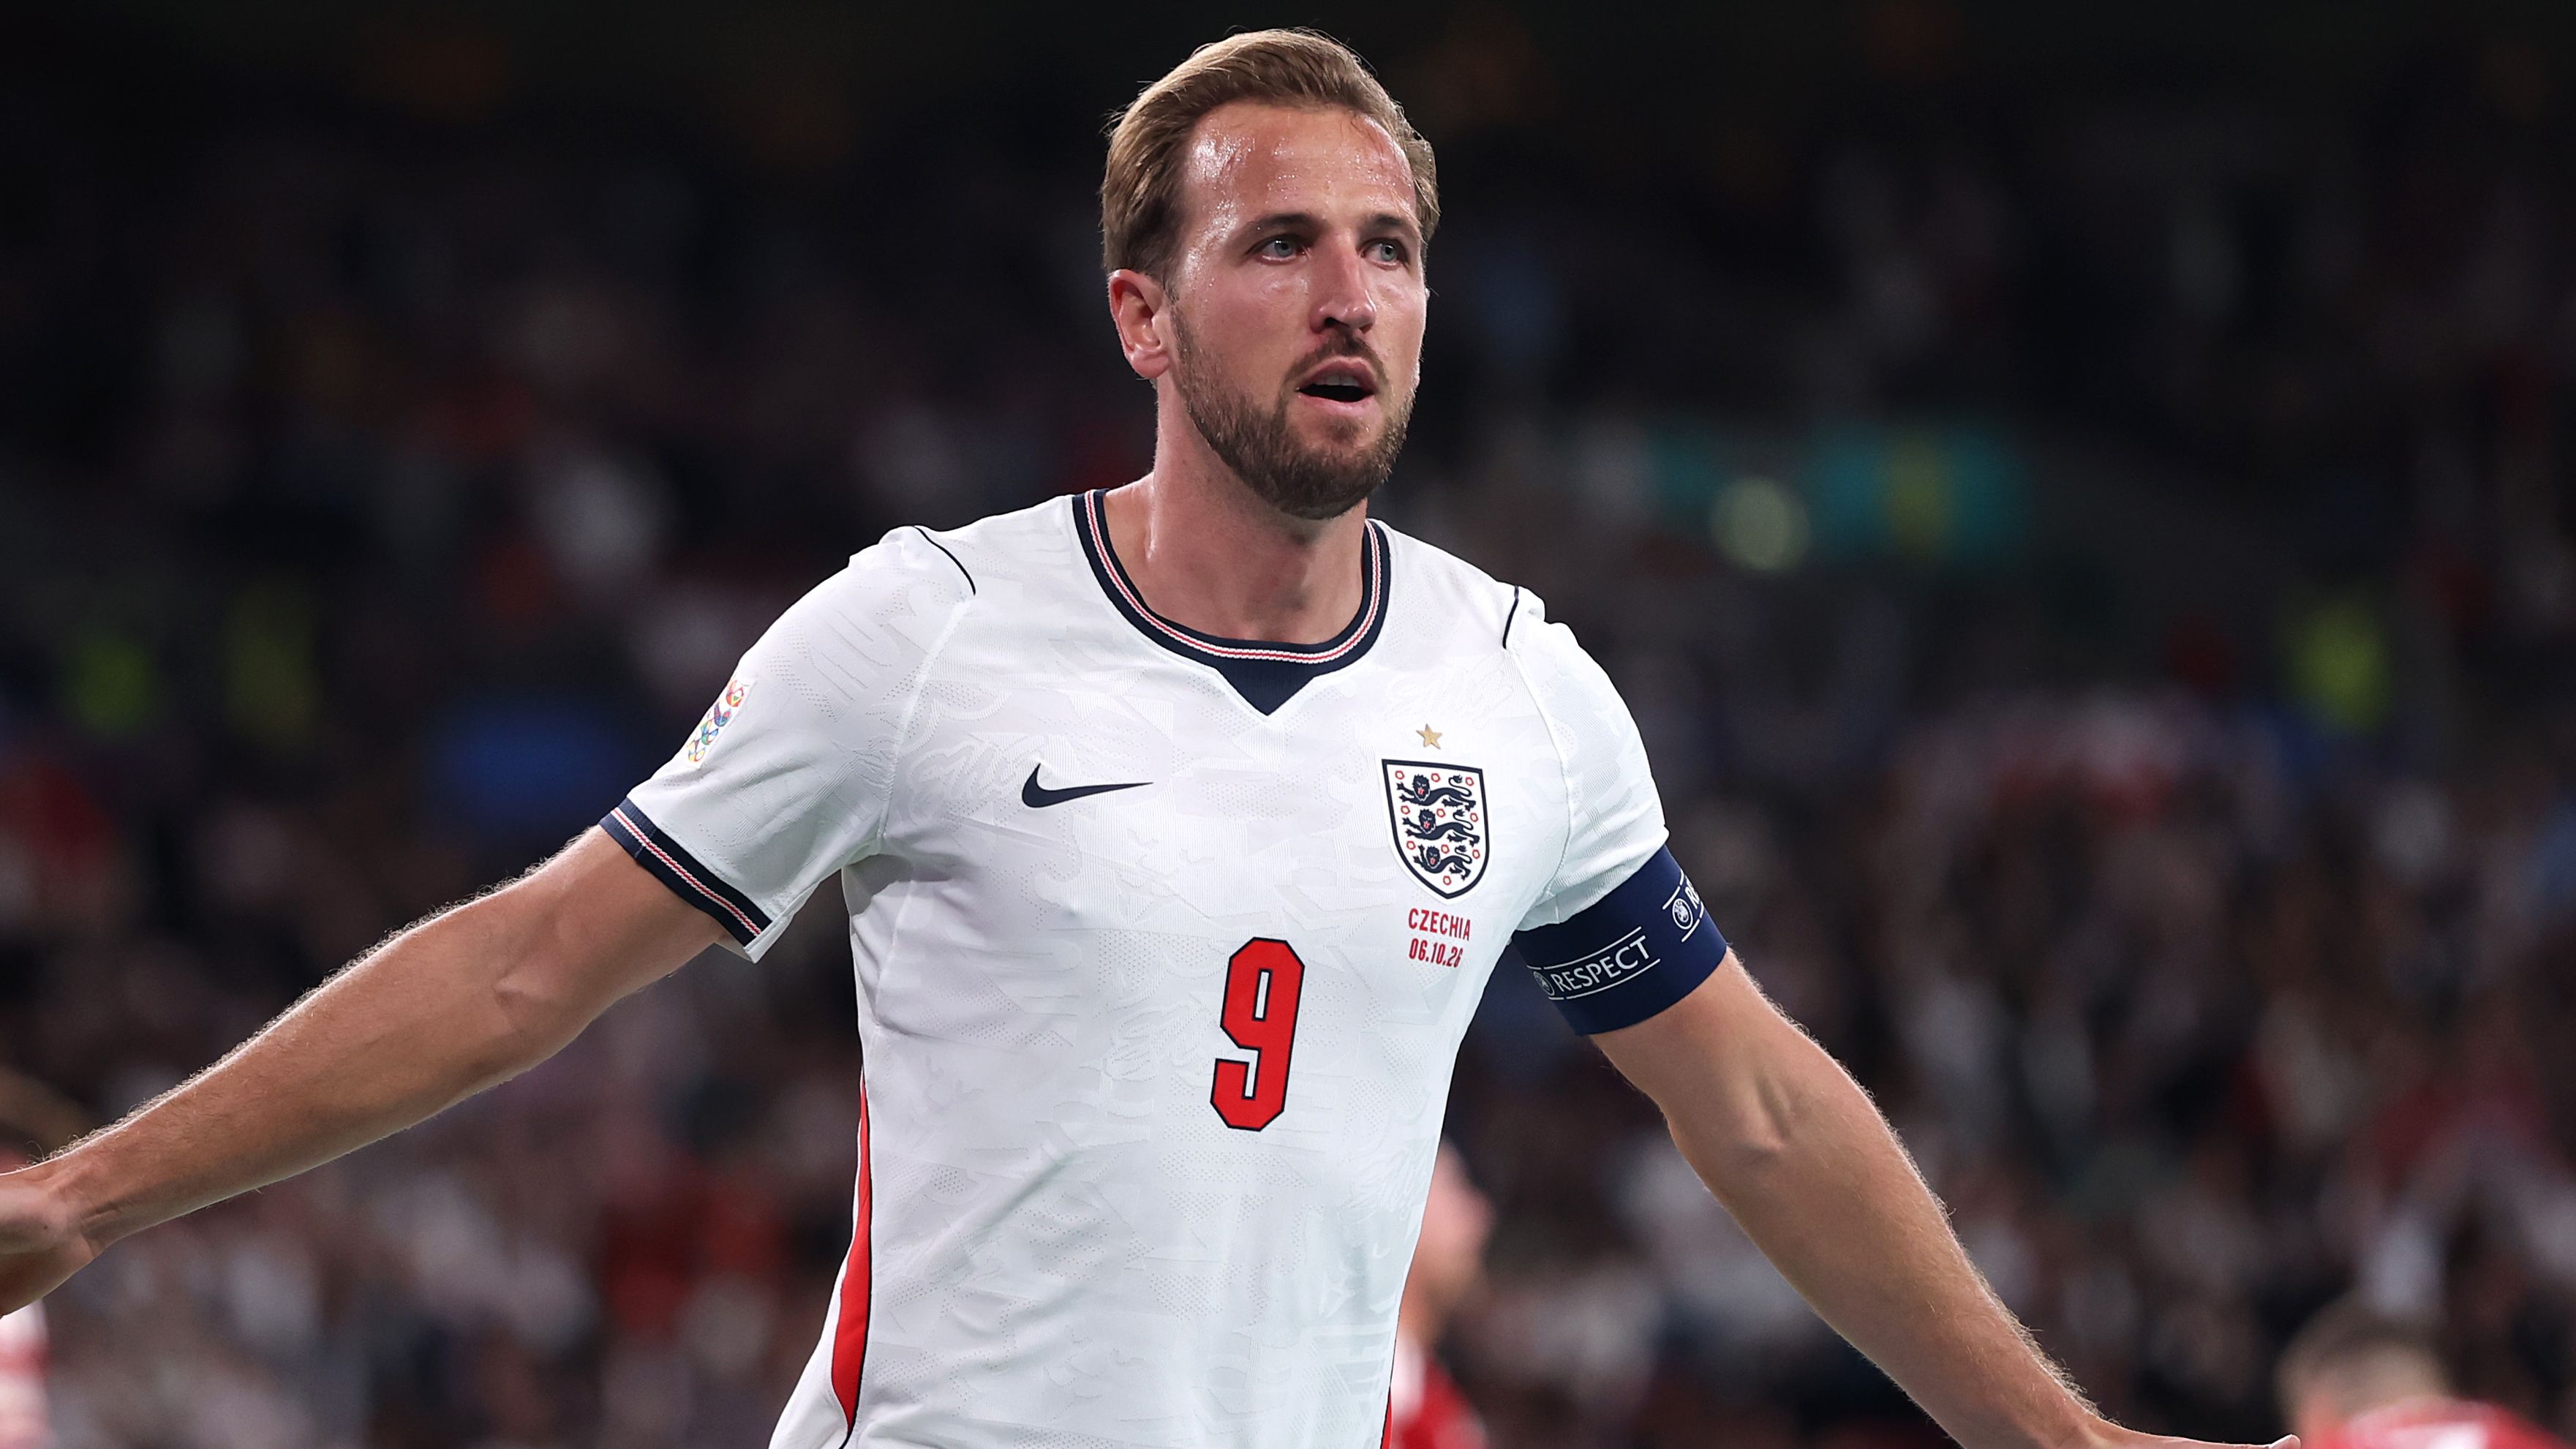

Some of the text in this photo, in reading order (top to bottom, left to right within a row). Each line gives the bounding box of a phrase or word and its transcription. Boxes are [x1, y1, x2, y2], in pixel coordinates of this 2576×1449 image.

[1408, 908, 1471, 941] CZECHIA
[1409, 938, 1464, 968] 06.10.26
[1550, 935, 1649, 993] RESPECT
[1210, 937, 1305, 1132] 9
